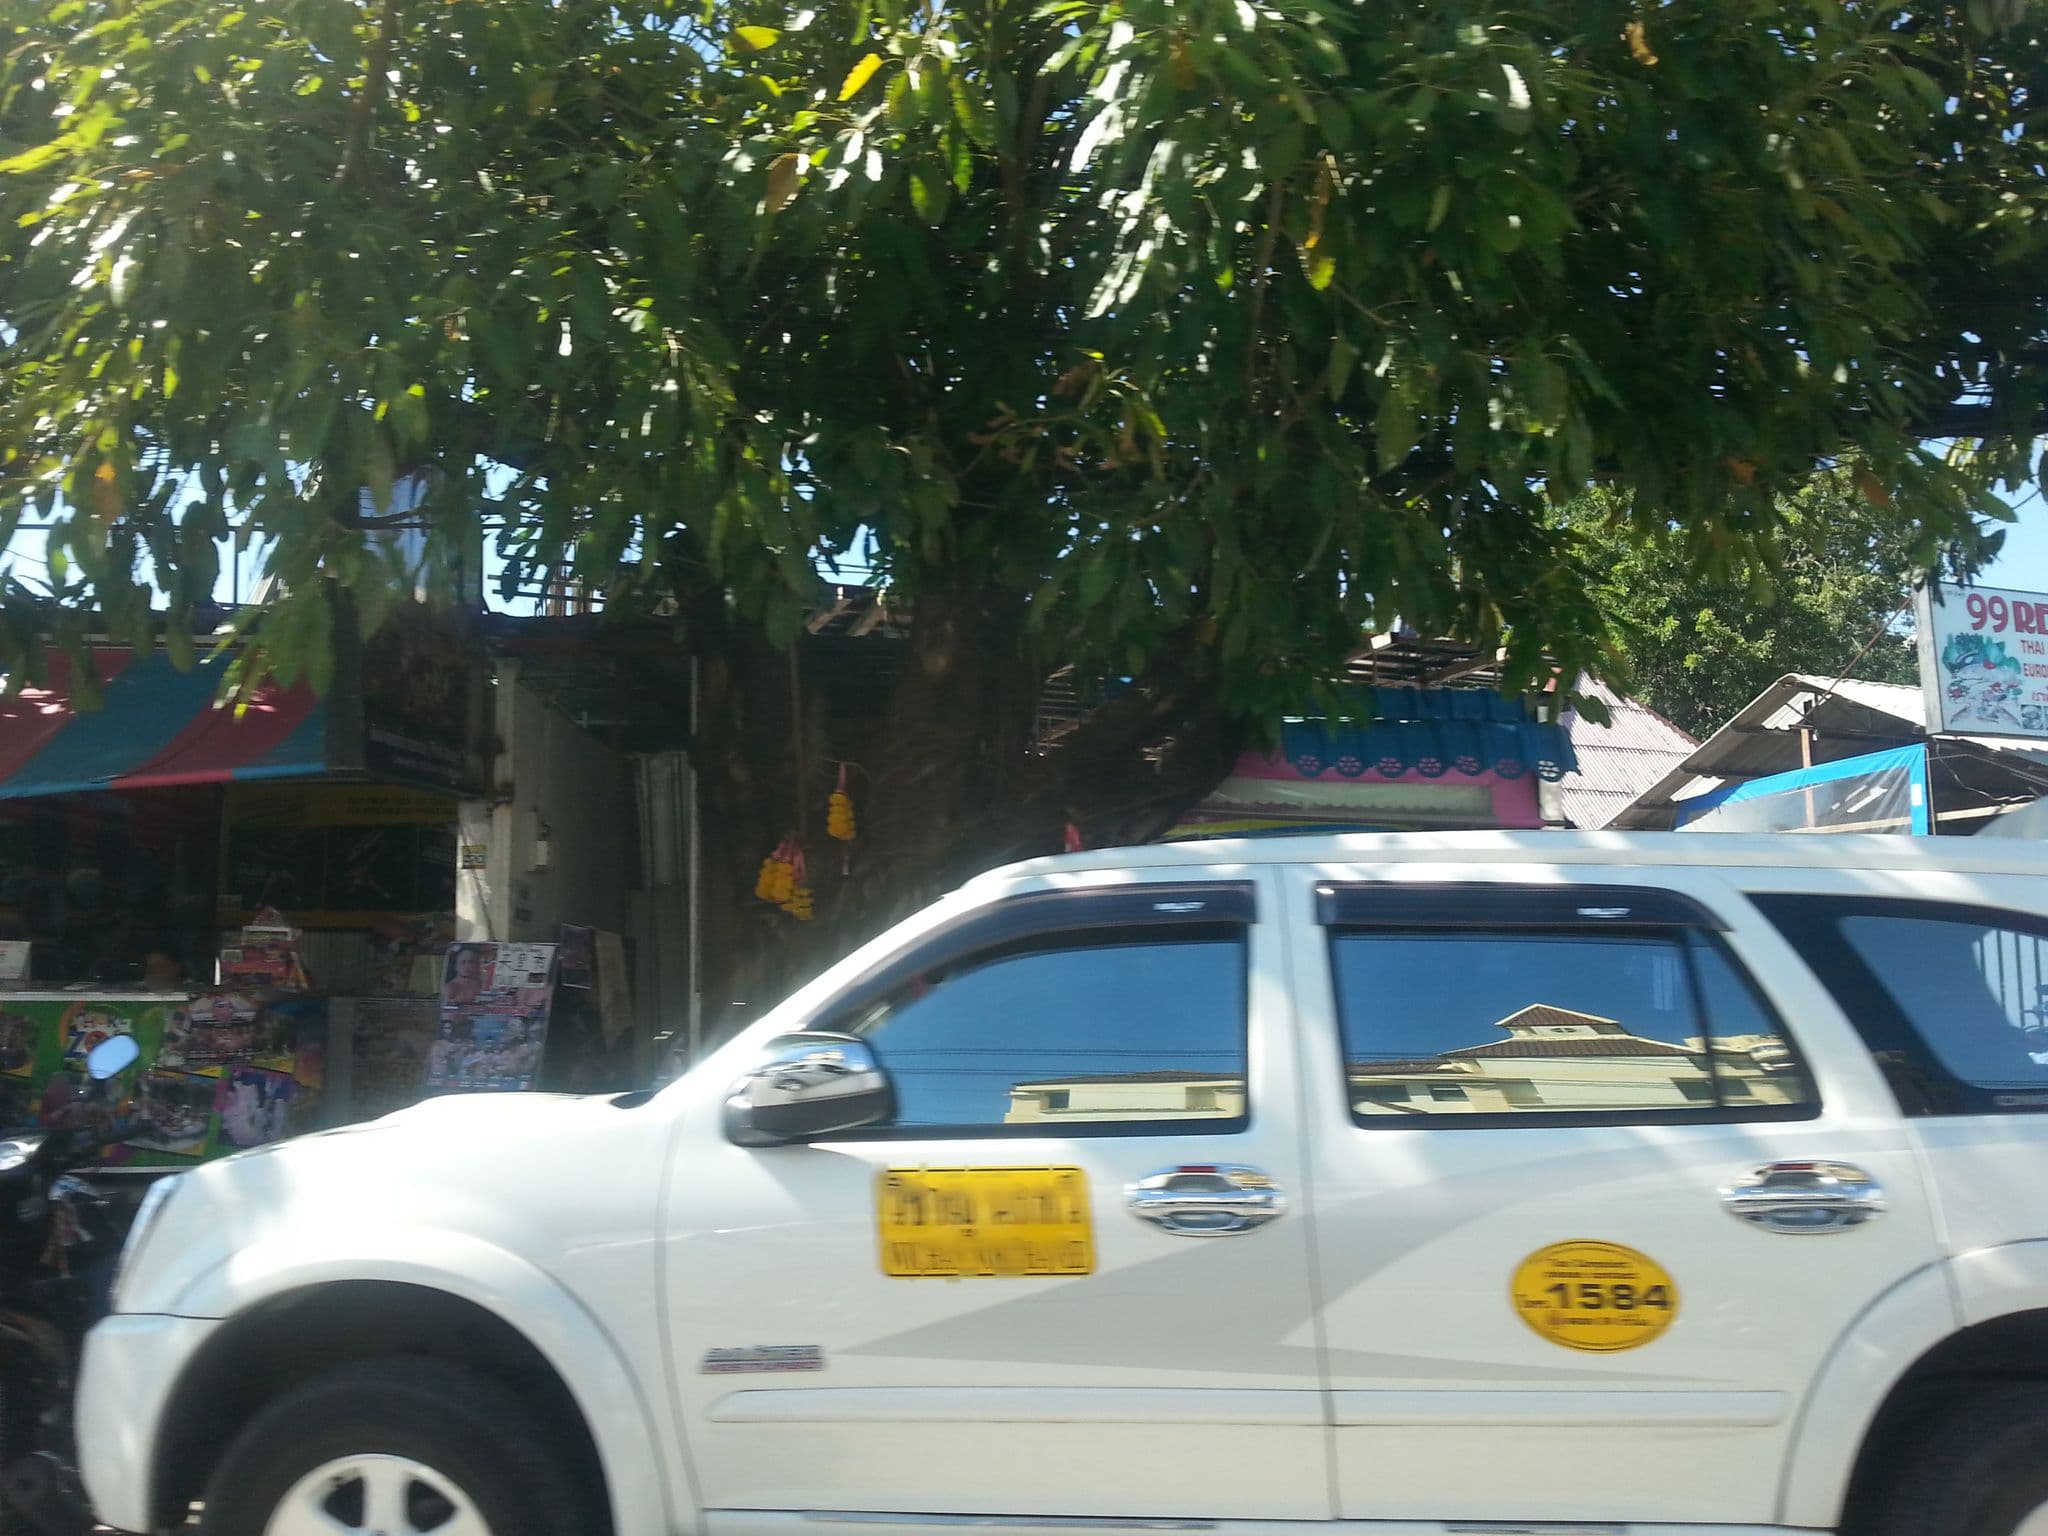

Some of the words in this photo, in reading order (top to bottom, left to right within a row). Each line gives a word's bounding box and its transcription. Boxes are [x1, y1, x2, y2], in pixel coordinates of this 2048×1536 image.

[1966, 593, 2009, 633] 99
[2020, 639, 2045, 655] THAI
[1544, 1283, 1672, 1310] 1584
